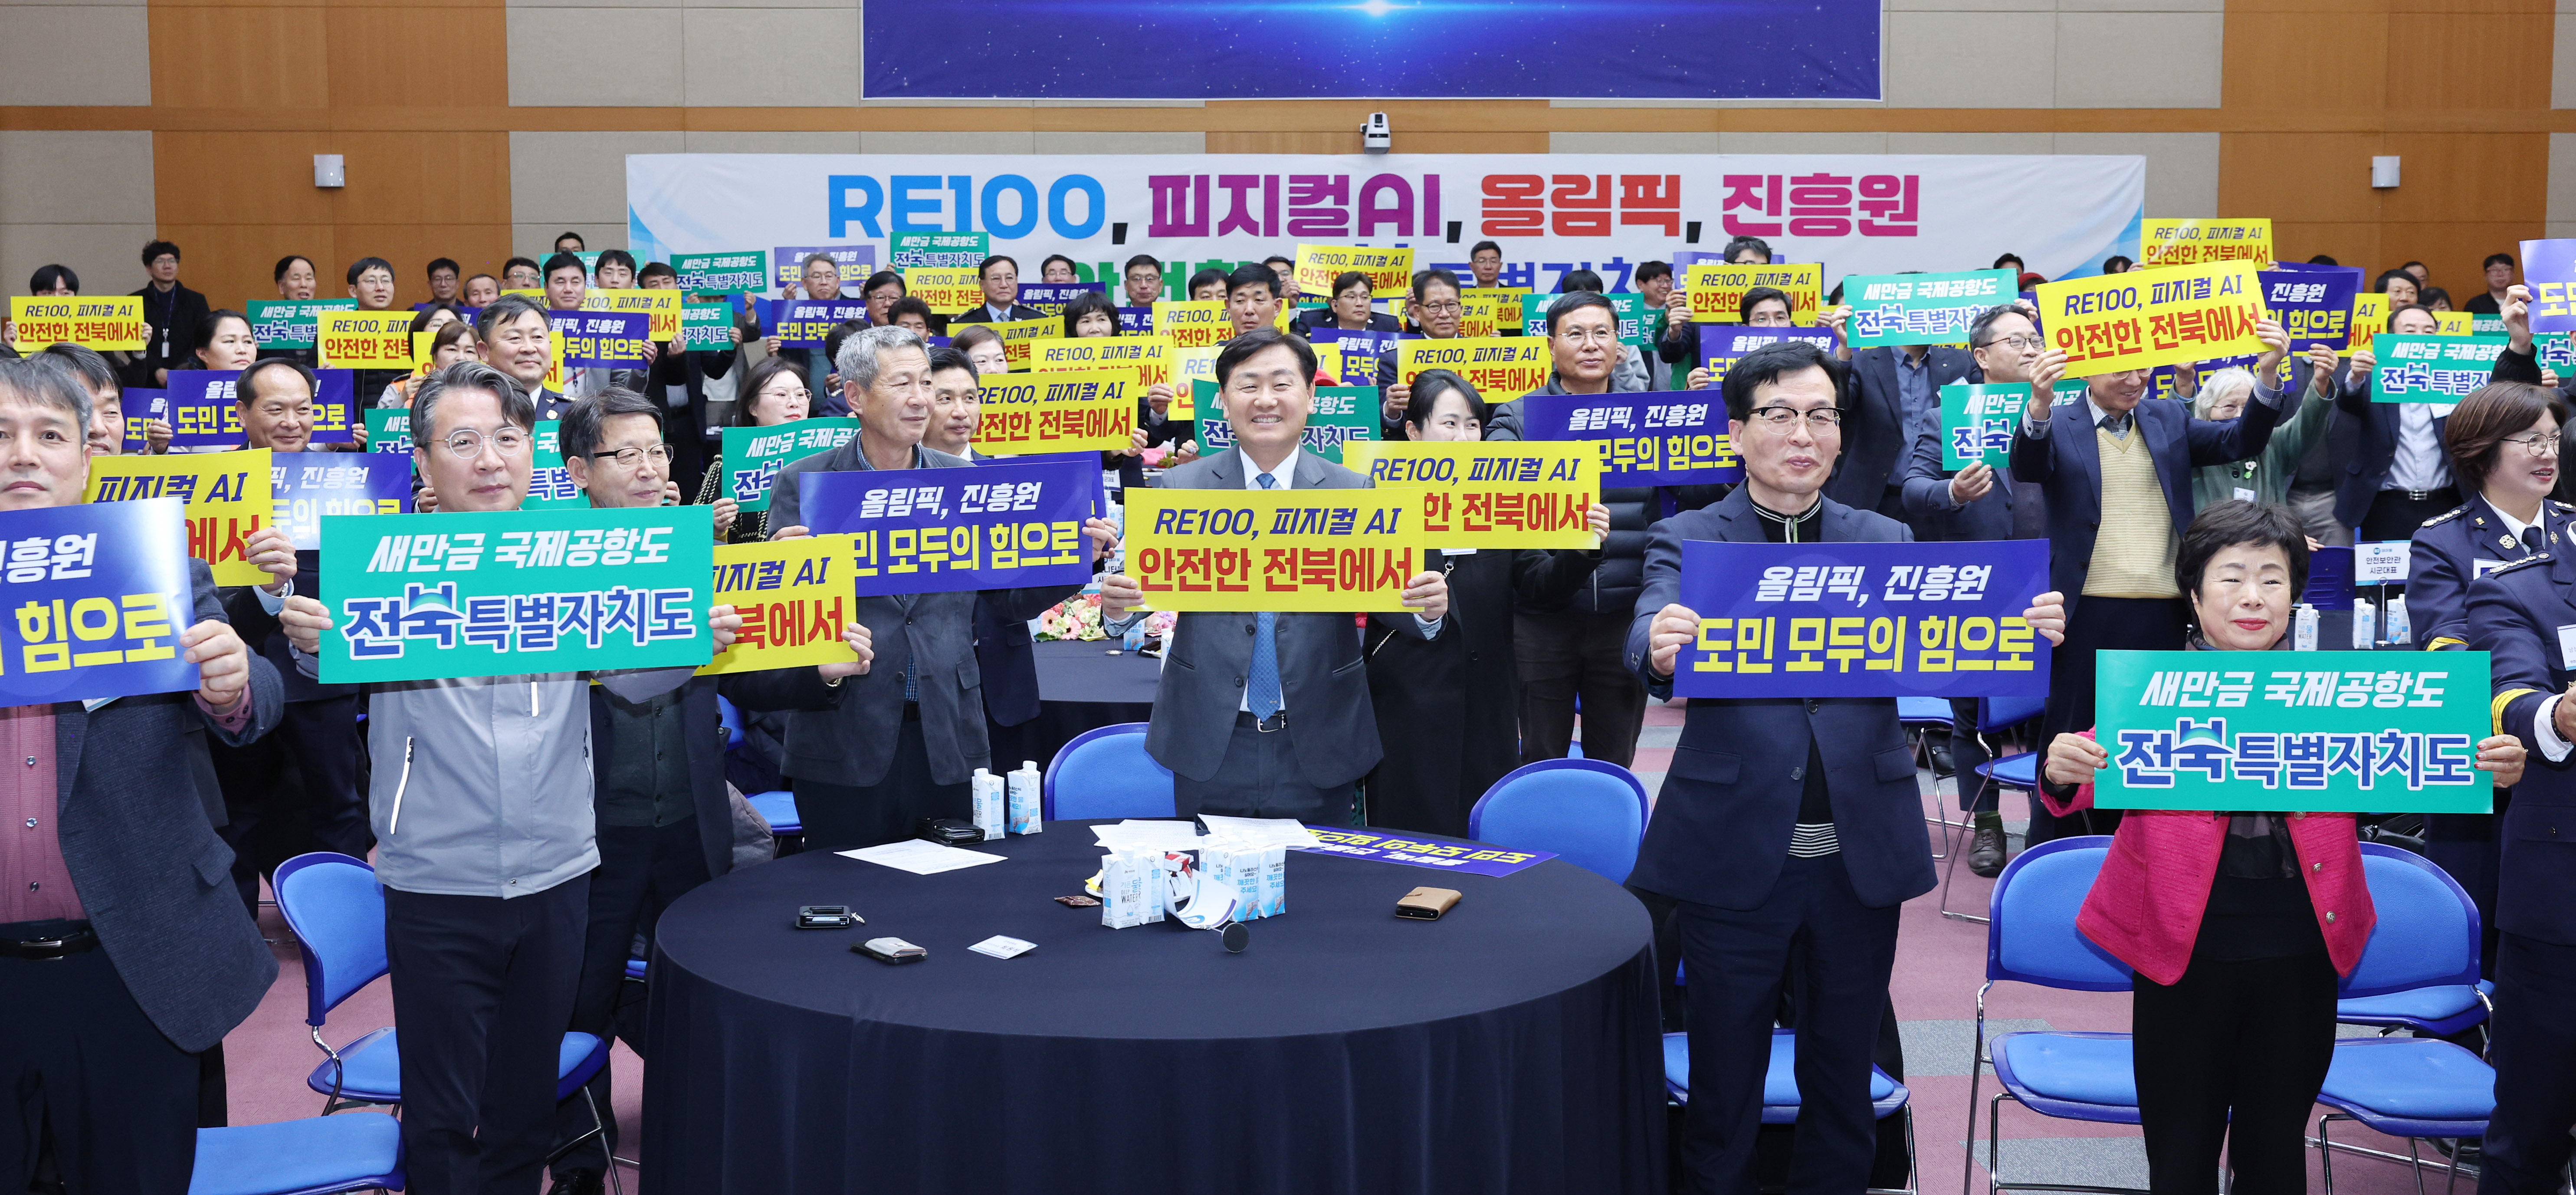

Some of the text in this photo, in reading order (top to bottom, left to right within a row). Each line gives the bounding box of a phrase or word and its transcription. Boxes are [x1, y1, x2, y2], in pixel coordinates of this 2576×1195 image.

[828, 174, 1918, 244] RE100, 피지컬AI, 올림픽, 진흥원
[900, 236, 979, 247] 새만금 국제공항도
[2155, 227, 2262, 242] RE100, 피지컬 AI
[681, 255, 758, 270] 새만금 국제공항도
[895, 248, 986, 268] 전북특별자치도
[1309, 253, 1406, 267] RE100, 피지컬 AI
[2146, 244, 2268, 266] 안전한 전북에서
[676, 271, 764, 291] 전북특별자치도
[779, 263, 873, 281] 도민 힘으로
[916, 275, 979, 287] RE100, 피지
[1371, 271, 1408, 289] 에서
[1701, 272, 1812, 288] RE100, 피지컬 AI
[956, 290, 985, 306] 전북
[1023, 289, 1056, 302] 올림픽,
[1863, 278, 1998, 301] 새만금 국제공항도
[2064, 274, 2242, 316] RE100, 피지컬 AI
[2270, 283, 2327, 303] 진흥원
[25, 303, 133, 318] RE100, 피지컬 AI
[260, 305, 297, 318] 새만금
[581, 297, 671, 311] E100, 피지컬 AI
[1476, 305, 1489, 315] AI
[1790, 290, 1816, 312] 에서
[2357, 304, 2376, 317] AI
[649, 314, 677, 333] 에서
[682, 307, 721, 321] 제공항도
[794, 305, 866, 320] 올림픽, 진흥원
[1166, 309, 1214, 324] RE100,
[19, 322, 141, 343] 안전한 전북에서
[332, 319, 413, 335] RE100, 피지
[585, 318, 626, 334] 진흥원
[777, 322, 802, 341] 도민
[1005, 324, 1056, 341] 피지컬 AI
[2057, 302, 2259, 362] 안전한 전북에서
[2288, 309, 2346, 339] 힘으로
[2348, 324, 2381, 346] 에서
[2445, 321, 2462, 332] AI
[325, 338, 378, 360] 안전한
[599, 338, 643, 360] 힘으로
[1045, 345, 1163, 363] RE100, 피지컬 AI
[1337, 336, 1375, 355] 올림픽,
[1413, 347, 1539, 365] RE100, 피지컬 AI
[2391, 342, 2506, 361] 새만금 국제공항
[1469, 366, 1546, 393] 전북에서
[979, 381, 1125, 405] RE100, 피지컬 AI
[1963, 393, 2024, 415] 새만금
[1310, 396, 1356, 415] 공항도
[177, 406, 218, 434] 도민
[312, 404, 346, 431] 으로
[1039, 407, 1131, 441] 전북에서
[1568, 403, 1708, 433] 올림픽, 진흥원
[745, 431, 792, 458] 새만금
[1599, 434, 1739, 473] 모두의 힘으로
[301, 466, 370, 490] 진흥원
[1370, 457, 1581, 486] RE100, 피지컬 AI
[93, 472, 248, 505] 피지컬 AI
[860, 482, 1042, 520] 올림픽, 진흥원
[1462, 492, 1589, 532] 전북에서
[1153, 508, 1260, 541] RE100,
[1269, 507, 1357, 535] 피지컬
[1363, 507, 1402, 534] AI
[184, 515, 259, 565] 에서
[365, 526, 674, 574] 새만금 국제공항도
[887, 521, 1081, 575] 모두의 힘으로
[792, 556, 831, 587] AI
[1138, 547, 1412, 592] 안전한 전북에서
[2366, 556, 2402, 565] 안전보안관
[1754, 564, 1993, 608] 올림픽, 진흥원
[340, 580, 697, 661] 전북특별자치도
[722, 596, 843, 653] 북에서
[15, 592, 176, 674] 힘으로
[1693, 614, 2035, 674] 도민 모두의 힘으로
[2139, 670, 2448, 709] 새만금 국제공항도
[2115, 717, 2475, 791] 전북특별자치도
[1121, 893, 1138, 904] WATER
